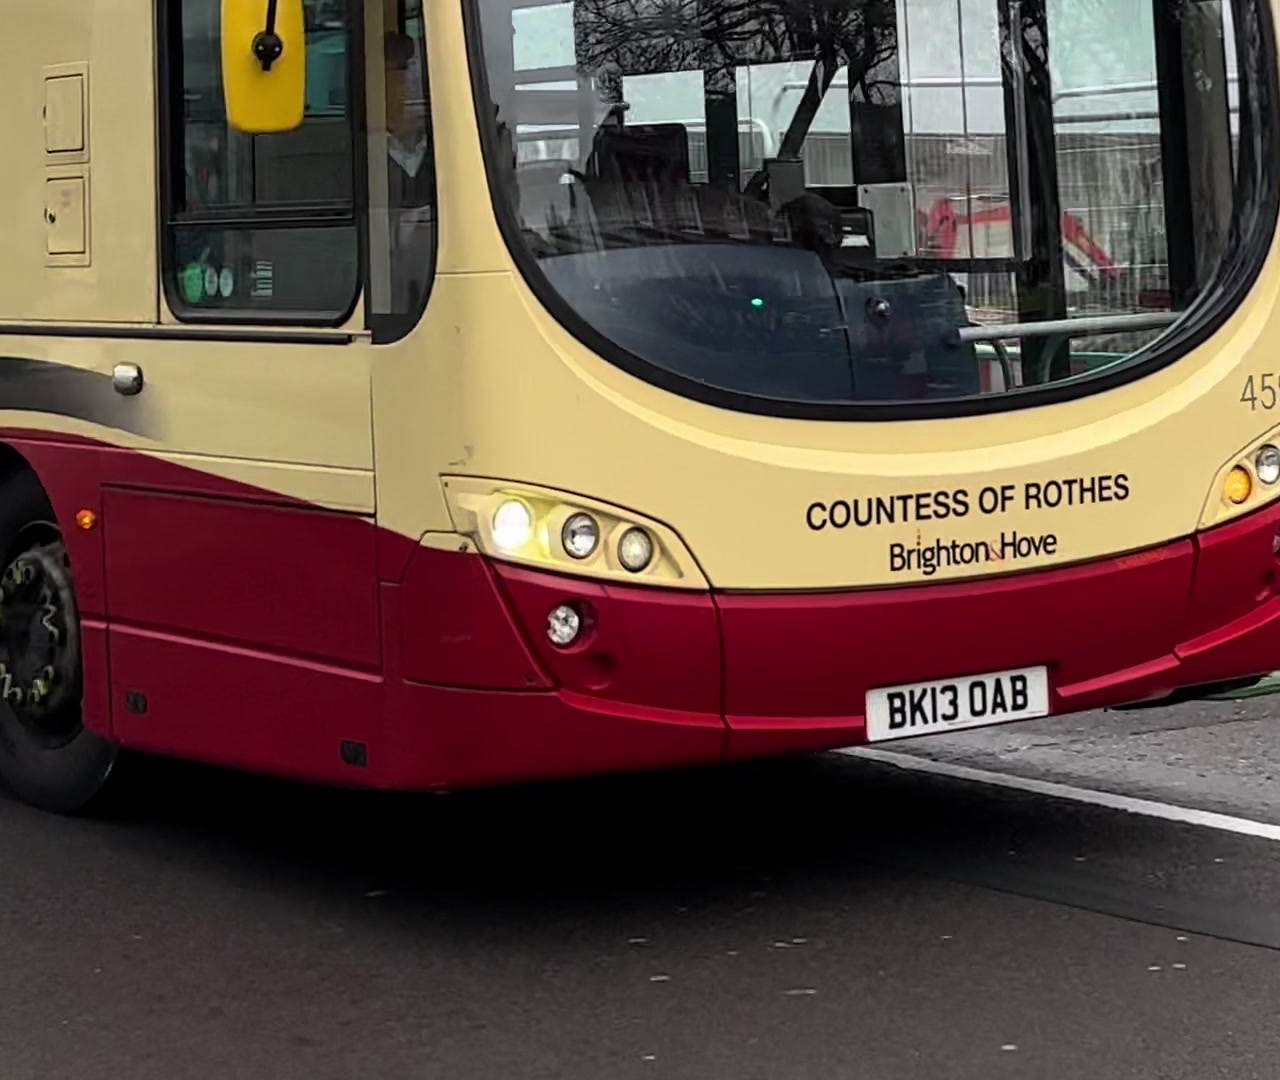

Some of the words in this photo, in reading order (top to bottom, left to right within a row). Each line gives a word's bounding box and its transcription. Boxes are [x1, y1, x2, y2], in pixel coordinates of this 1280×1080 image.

[806, 488, 970, 531] COUNTESS
[978, 484, 1016, 514] OF
[1024, 474, 1130, 510] ROTHES
[887, 684, 959, 730] BK13
[969, 674, 1029, 718] OAB
